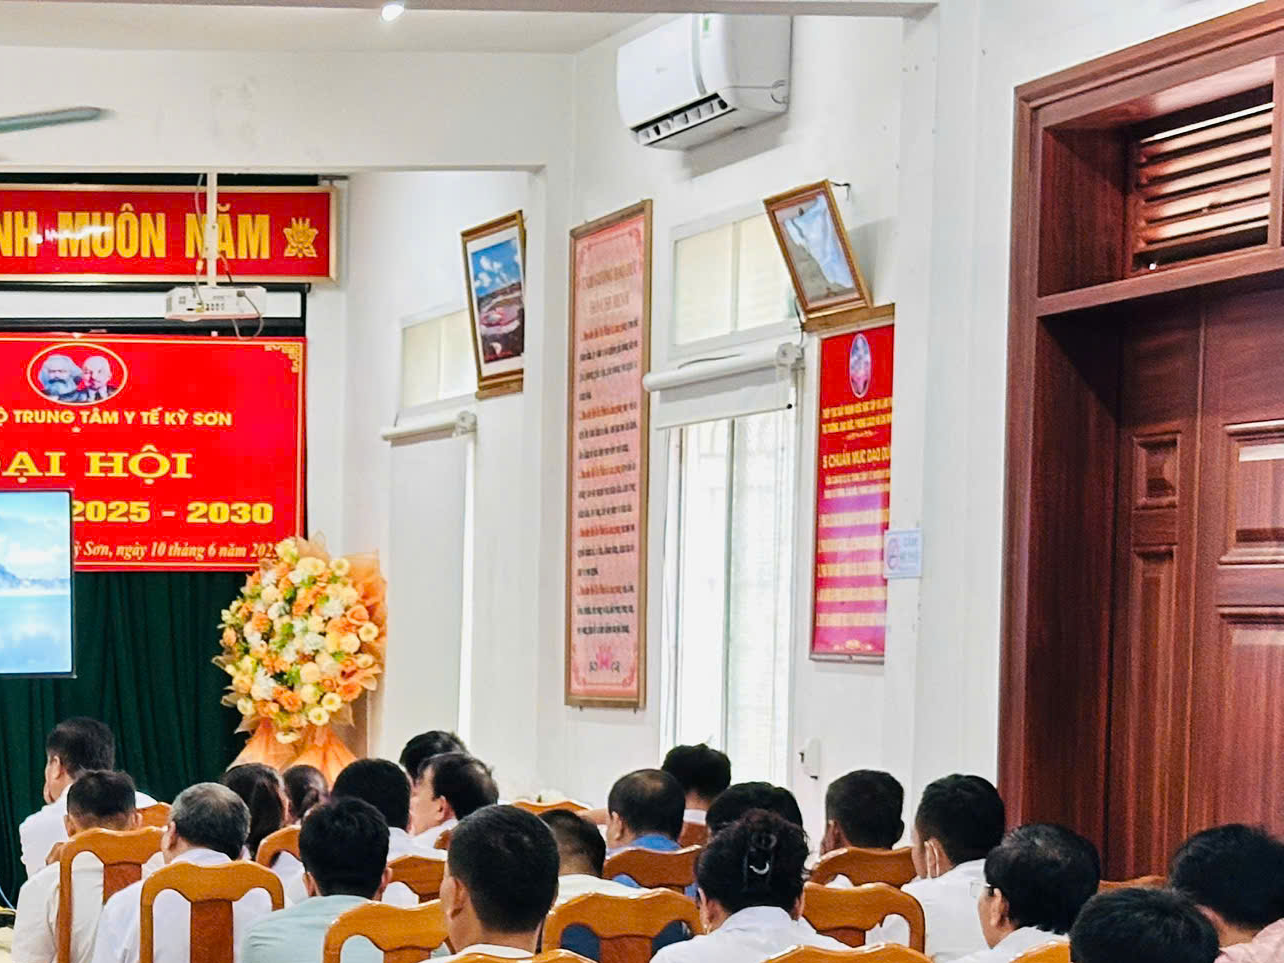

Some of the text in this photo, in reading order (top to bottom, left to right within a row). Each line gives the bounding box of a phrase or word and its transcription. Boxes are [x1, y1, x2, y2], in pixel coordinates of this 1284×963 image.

[58, 202, 166, 259] MUÔN
[186, 204, 271, 260] NĂM
[13, 411, 76, 424] TRUNG
[80, 406, 119, 425] TÂM
[124, 411, 135, 425] Y
[139, 405, 161, 425] TẾ
[165, 407, 188, 427] KỲ
[192, 410, 232, 427] SƠN
[85, 444, 192, 486] HỘI
[72, 500, 151, 523] 2025
[186, 502, 274, 524] 2030
[83, 541, 113, 557] Sơn,
[116, 542, 147, 560] ngày
[151, 542, 165, 556] 10
[168, 542, 205, 561] tháng
[207, 543, 217, 557] 6
[218, 543, 247, 558] năm
